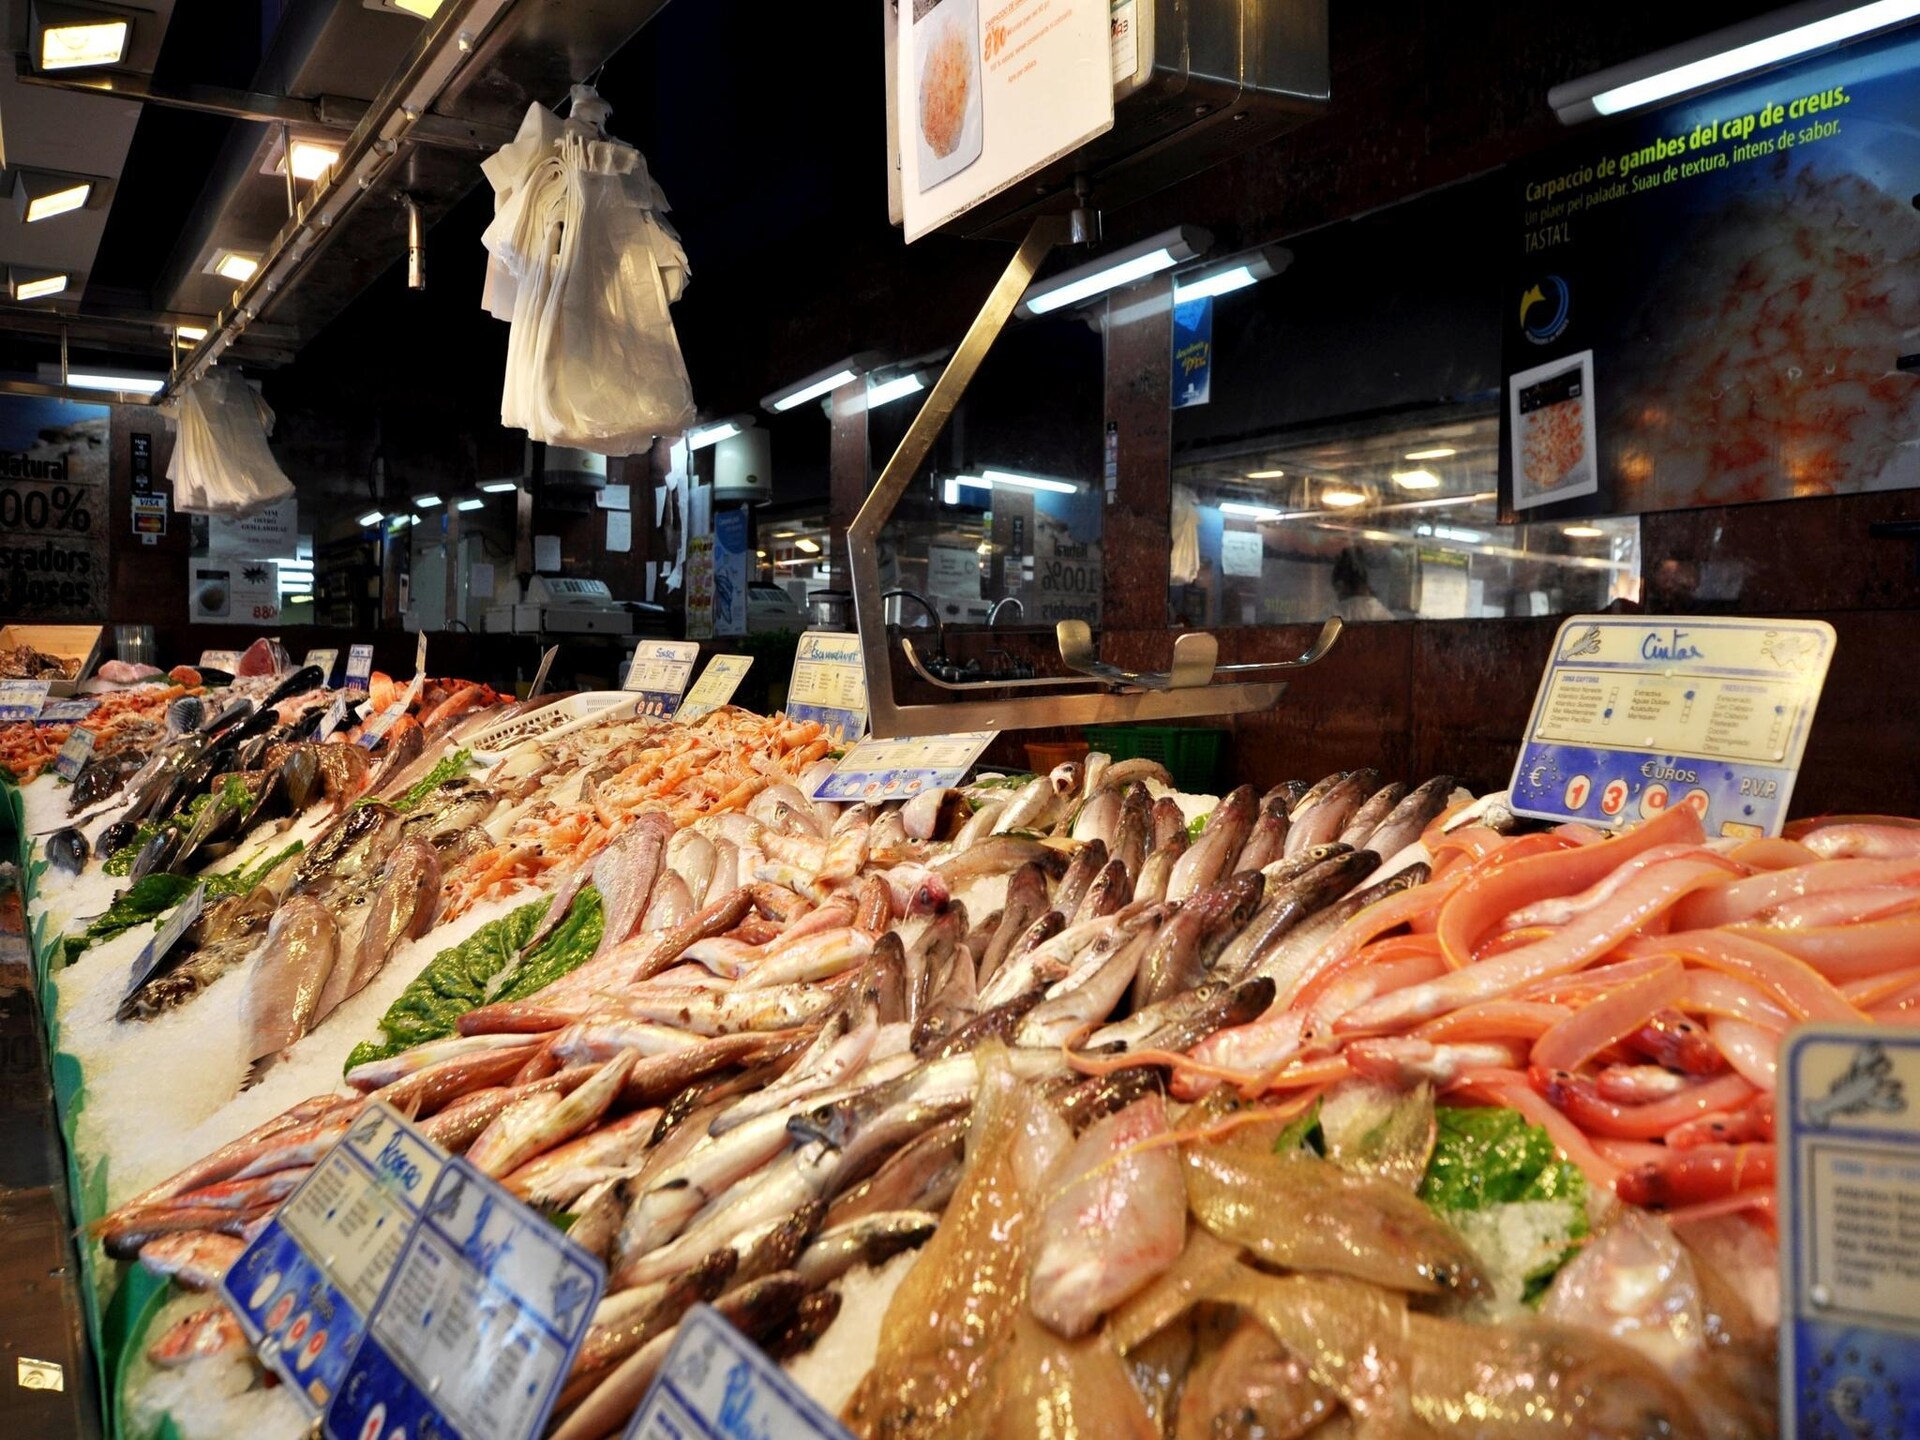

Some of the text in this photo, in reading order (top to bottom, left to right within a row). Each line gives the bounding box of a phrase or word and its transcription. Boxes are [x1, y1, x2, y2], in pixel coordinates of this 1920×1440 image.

[1525, 119, 1842, 226] Un plaer pel paladar. Suau de textura, intens de sabor.
[1526, 85, 1850, 202] Carpaccio de gambes del cap de creus.
[139, 498, 159, 506] VISA
